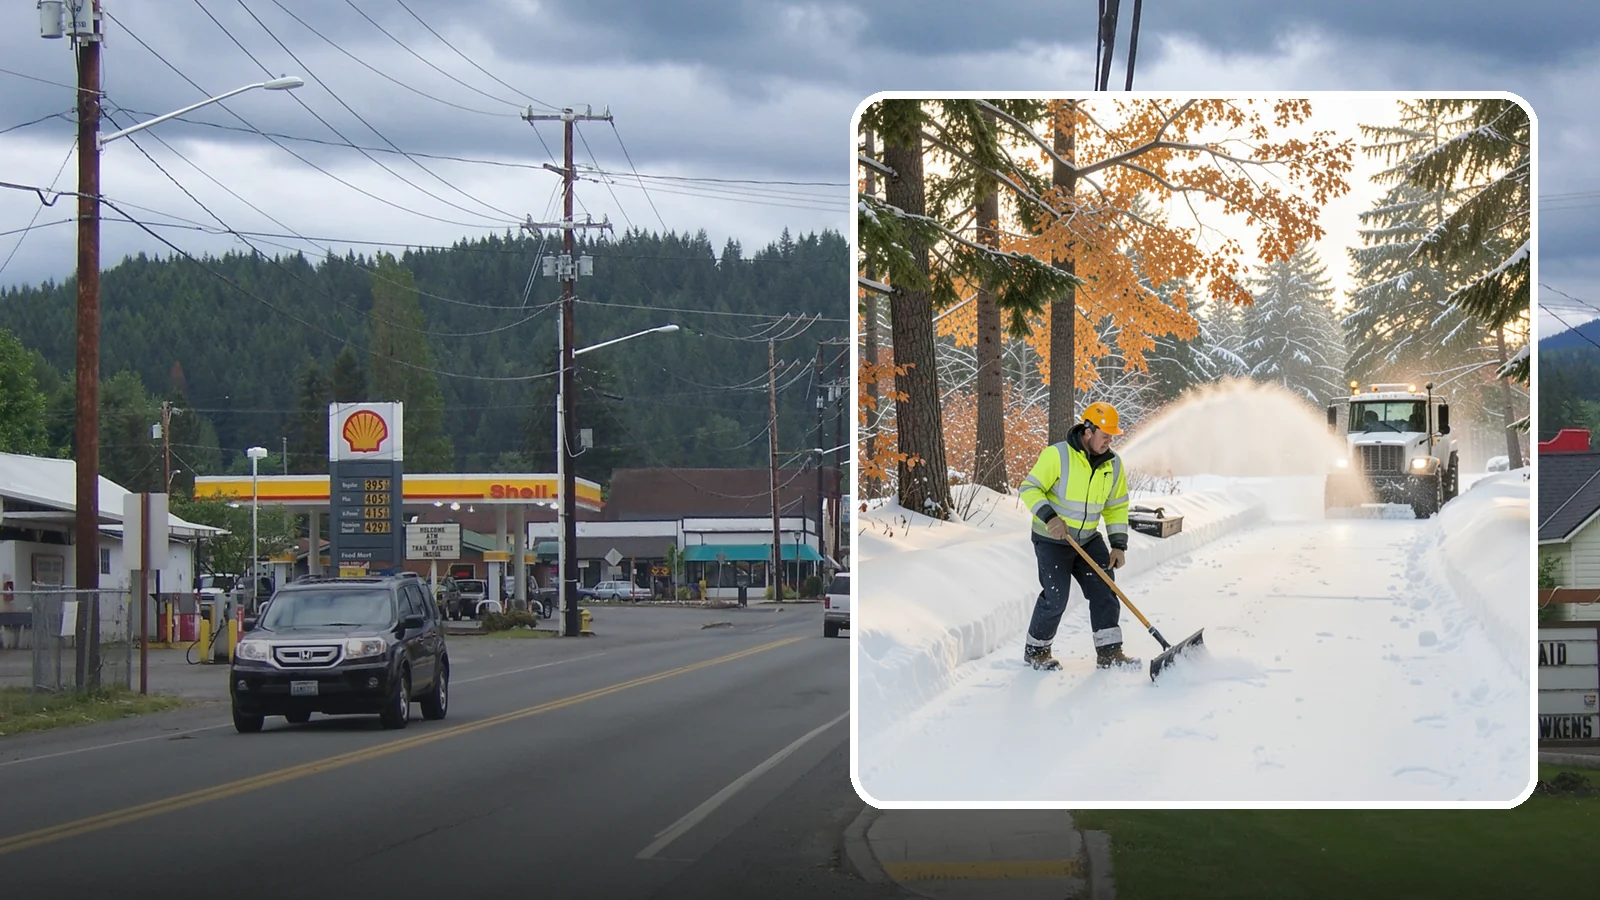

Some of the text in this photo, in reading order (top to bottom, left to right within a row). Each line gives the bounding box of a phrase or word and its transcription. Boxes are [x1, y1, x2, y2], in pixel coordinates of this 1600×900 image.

[366, 480, 384, 490] 395
[490, 484, 547, 499] Shell
[366, 494, 384, 504] 405
[366, 508, 383, 517] 415
[366, 522, 383, 532] 429
